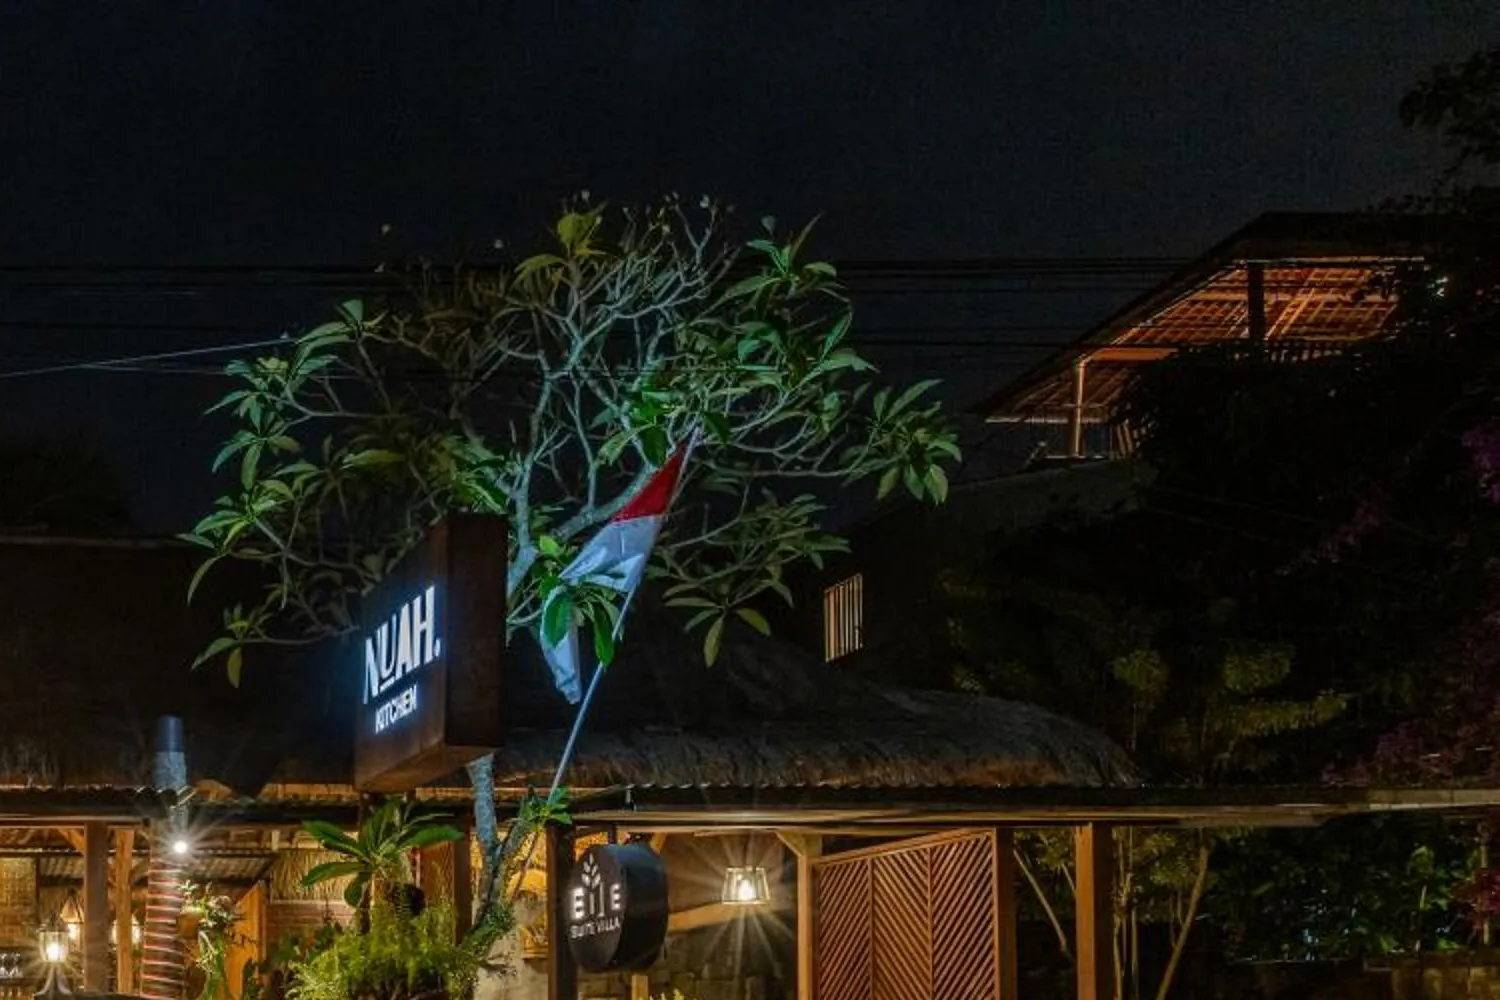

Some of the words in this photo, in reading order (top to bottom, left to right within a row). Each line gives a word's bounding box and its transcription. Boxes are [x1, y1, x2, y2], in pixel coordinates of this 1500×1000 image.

[375, 684, 418, 735] KITCHEN
[570, 921, 596, 939] SUITE
[597, 916, 620, 933] VILLA
